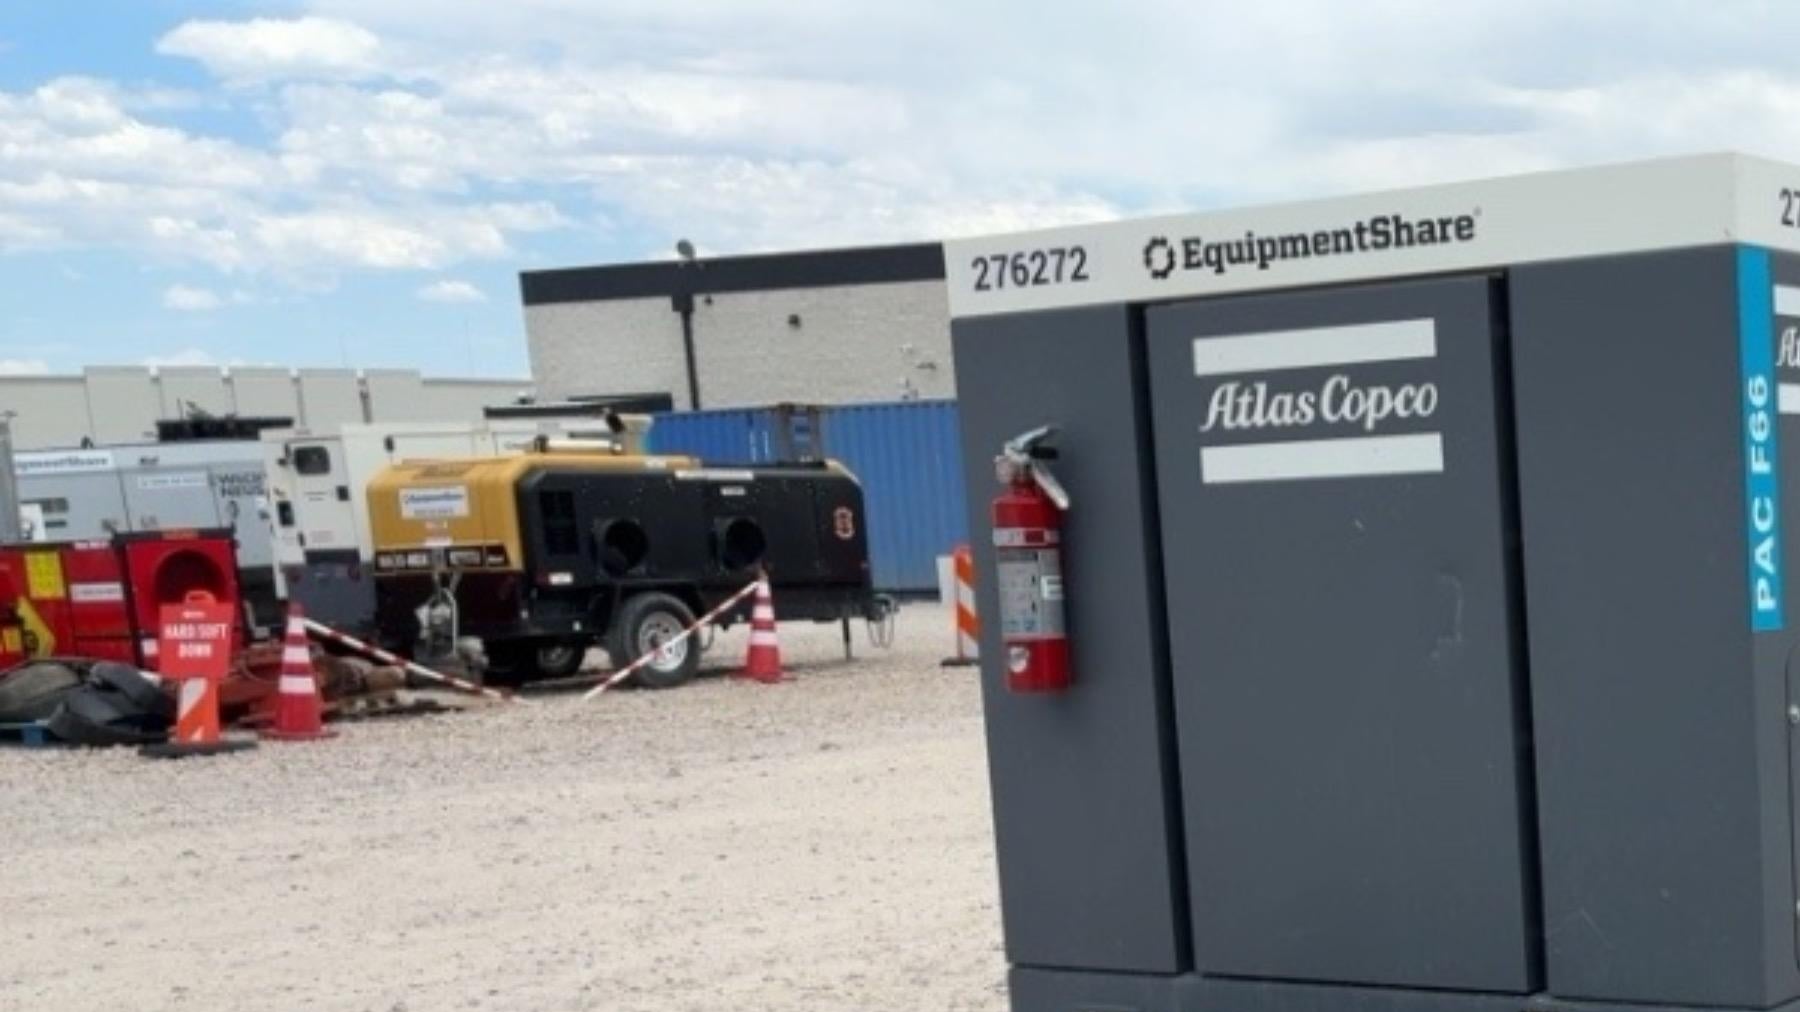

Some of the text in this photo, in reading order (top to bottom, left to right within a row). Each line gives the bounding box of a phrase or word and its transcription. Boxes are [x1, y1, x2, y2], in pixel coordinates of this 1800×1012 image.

[972, 245, 1089, 290] 276272
[1182, 214, 1475, 275] EquipmentShare
[1199, 374, 1439, 431] Atlas Copco
[1748, 375, 1777, 611] PAC F66
